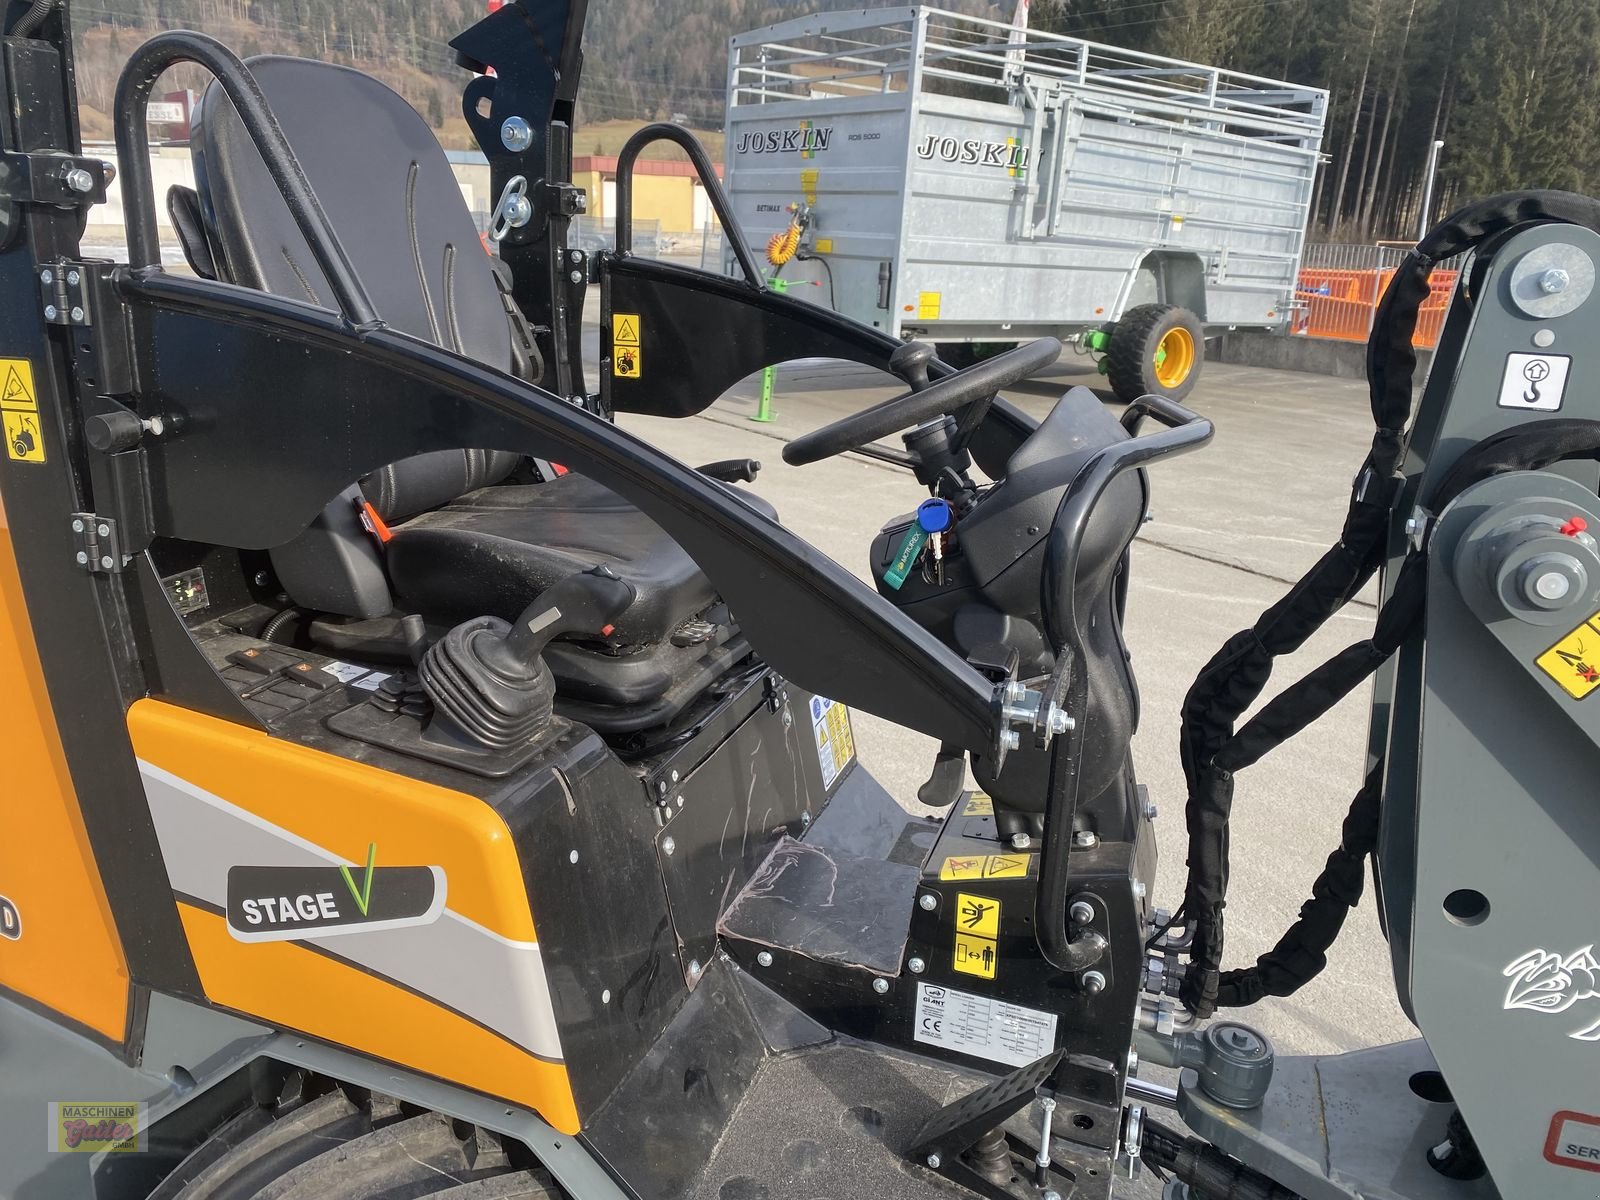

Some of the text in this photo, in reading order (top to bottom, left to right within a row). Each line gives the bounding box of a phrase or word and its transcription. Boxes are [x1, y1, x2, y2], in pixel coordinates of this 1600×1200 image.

[736, 127, 832, 154] JOSKIN
[901, 531, 921, 562] MOTOREX
[242, 892, 339, 925] STAGE
[922, 996, 945, 1006] GIANT
